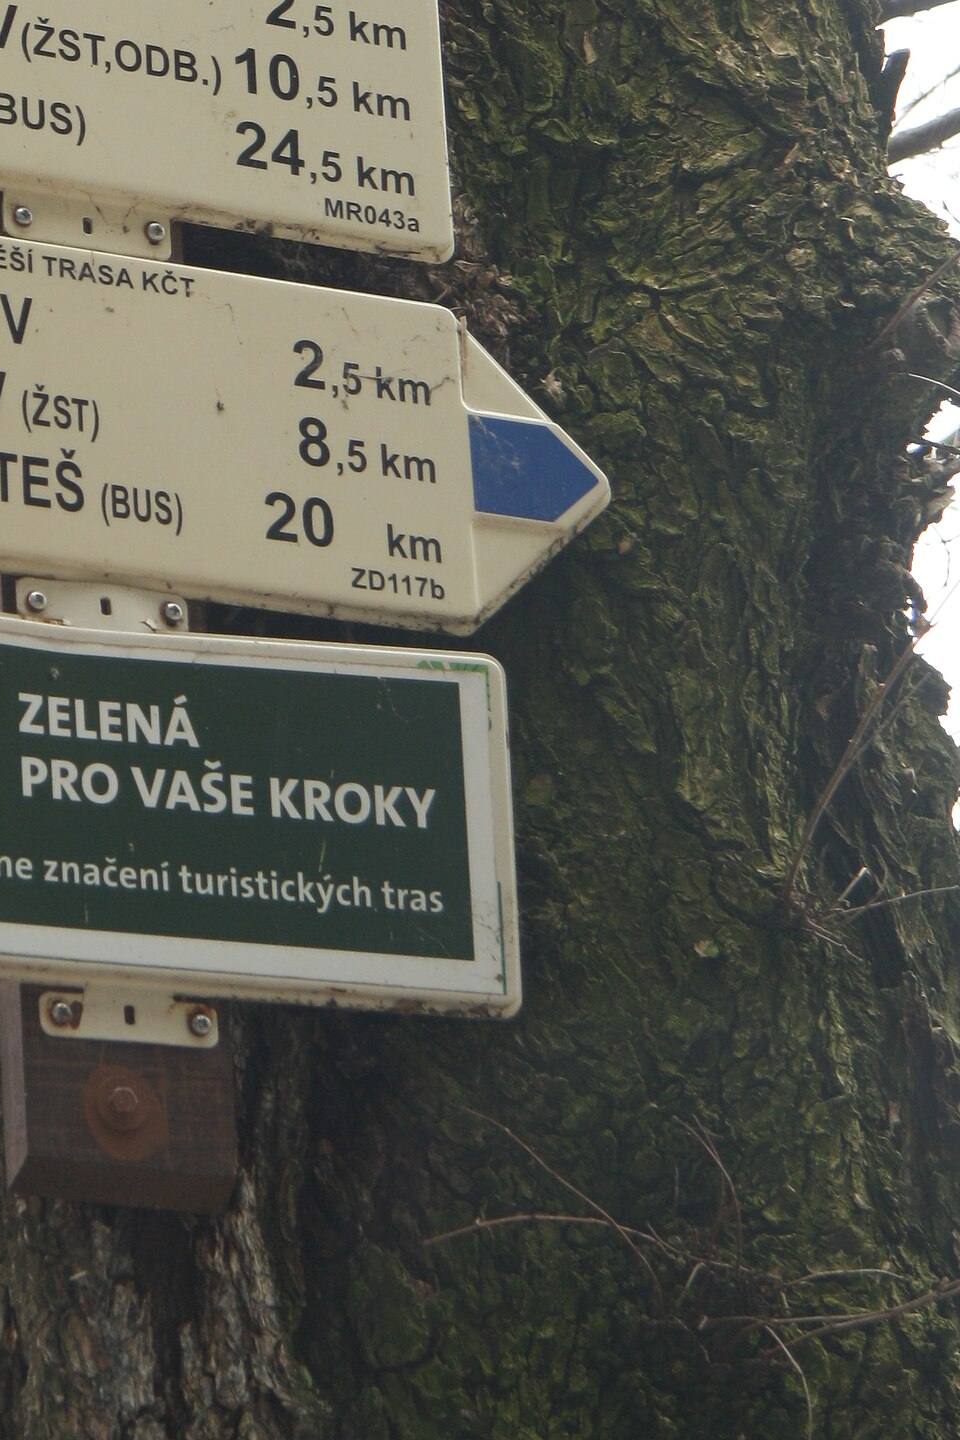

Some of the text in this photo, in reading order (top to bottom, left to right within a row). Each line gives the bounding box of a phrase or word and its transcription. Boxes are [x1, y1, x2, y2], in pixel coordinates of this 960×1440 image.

[348, 11, 407, 51] km
[235, 47, 338, 109] 10,5
[352, 81, 411, 122] km
[236, 120, 342, 184] 24,5
[356, 156, 415, 196] km
[324, 197, 420, 233] MR043a
[42, 256, 134, 289] TRASA
[142, 269, 195, 298] KČT
[293, 339, 362, 399] 2,5
[375, 366, 431, 406] km
[21, 383, 100, 443] (ŽST)
[298, 416, 367, 476] 8,5
[380, 443, 437, 484] km
[101, 482, 183, 536] (BUS)
[265, 491, 334, 547] 20
[386, 523, 442, 563] km
[351, 567, 445, 600] ZD117b
[18, 692, 200, 748] ZELENÁ
[21, 756, 436, 829] PRO VAŠE KROKY
[44, 857, 169, 892] značení
[179, 864, 371, 914] turistických
[381, 881, 444, 913] tras
